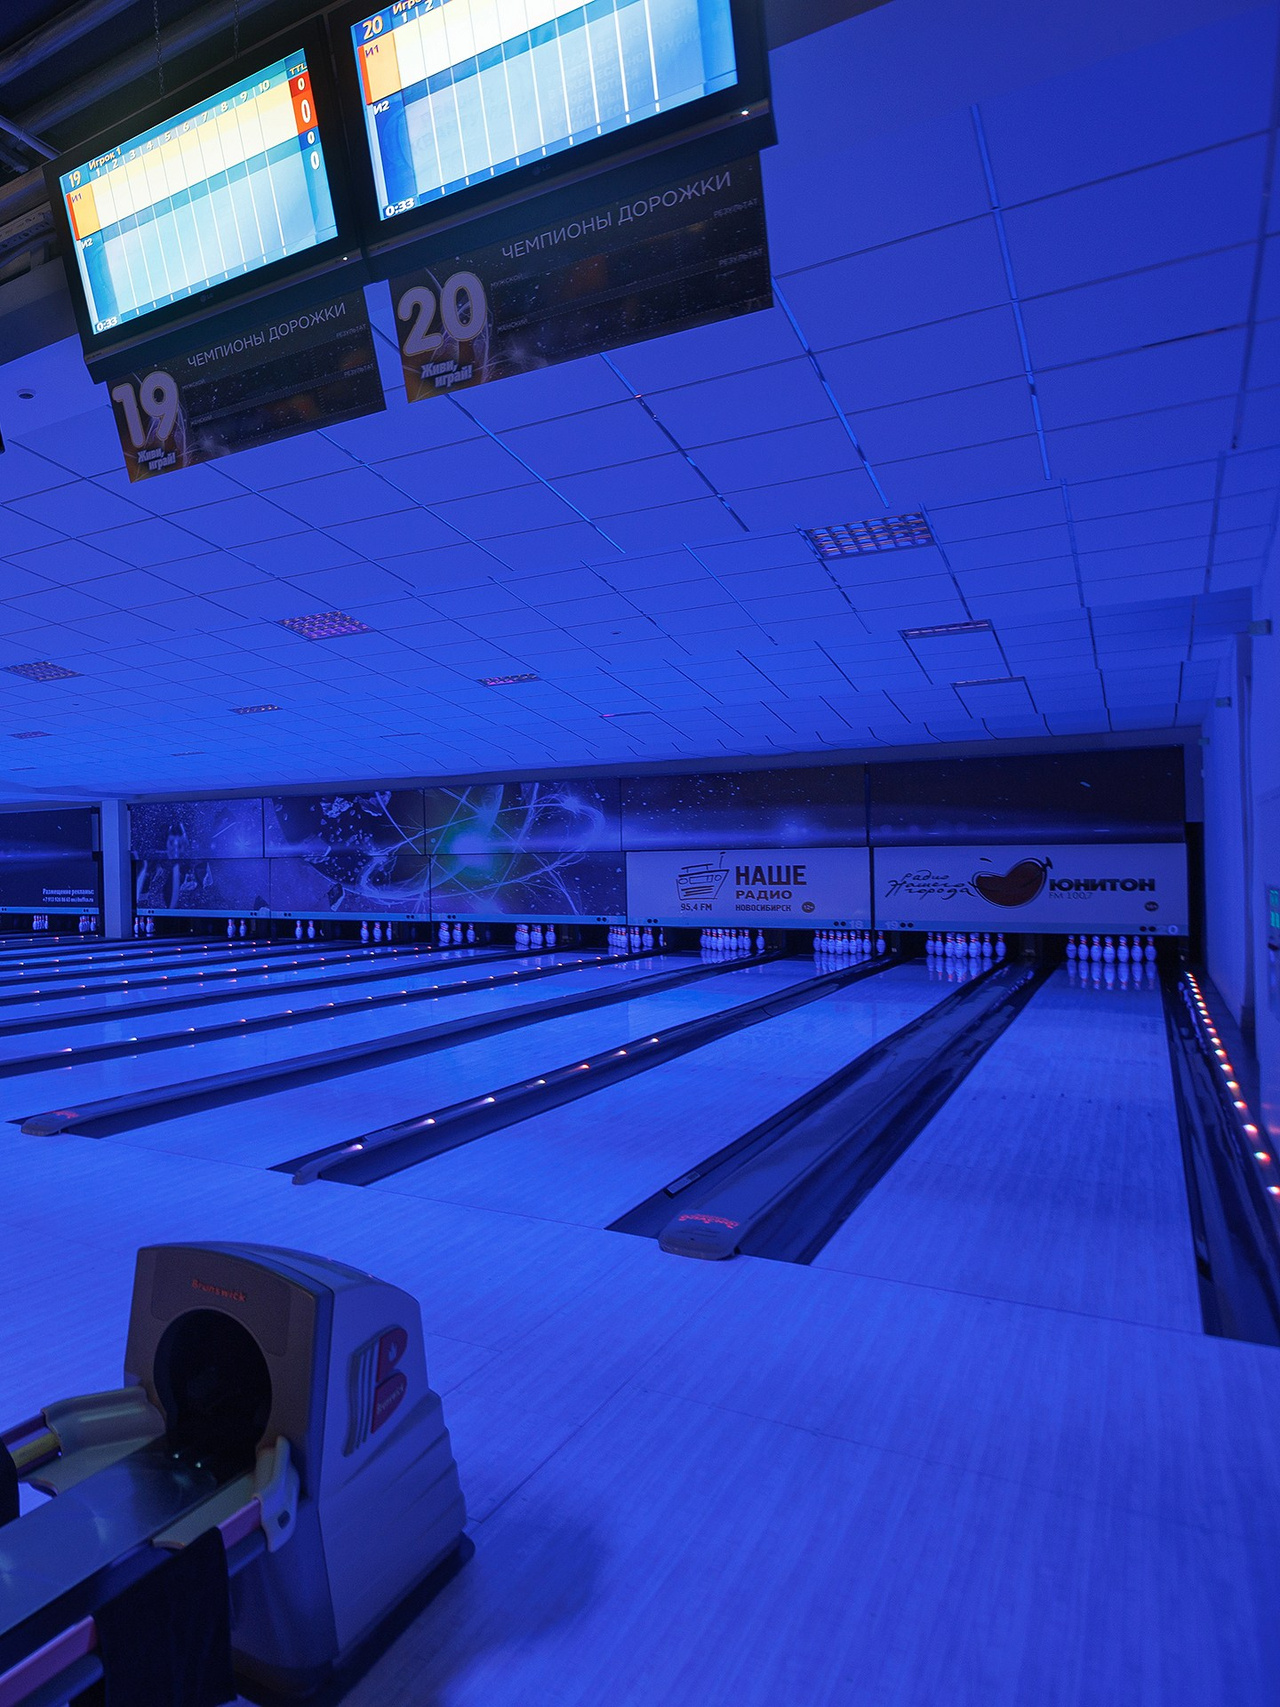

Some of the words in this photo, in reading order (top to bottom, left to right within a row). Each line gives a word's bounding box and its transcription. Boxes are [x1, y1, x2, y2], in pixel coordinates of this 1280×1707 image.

[402, 12, 408, 23] 1
[362, 15, 384, 40] 20
[365, 44, 380, 57] И1
[289, 63, 308, 76] TTL
[297, 78, 305, 91] 0
[301, 99, 311, 123] 0
[373, 100, 389, 115] И2
[95, 168, 101, 178] 1
[112, 158, 119, 169] 2
[129, 150, 136, 160] 3
[146, 141, 154, 151] 4
[164, 132, 171, 142] 5
[182, 122, 190, 132] 6
[202, 112, 209, 123] 7
[221, 102, 228, 112] 8
[240, 92, 248, 103] 9
[258, 80, 270, 93] 10
[307, 131, 315, 144] 0
[88, 152, 115, 171] Игрок
[310, 151, 320, 170] 0
[68, 170, 81, 188] 19
[71, 193, 83, 204] И1
[385, 197, 414, 217] 0:33
[502, 211, 612, 259] ЧЕМПИОНЫ
[618, 171, 732, 226] ДОРОЖКИ
[713, 198, 759, 218] РЕЗУЛЬТАТ
[80, 237, 93, 250] И2
[718, 247, 764, 267] РЕЗУЛЬТАТ
[397, 270, 487, 357] 20
[96, 317, 118, 332] 0:33
[187, 331, 265, 368] ЧЕМПИОНЫ
[269, 302, 346, 343] ДОРОЖКИ
[421, 360, 459, 380] Живи,
[434, 364, 473, 388] играй!
[111, 370, 179, 448] 19
[148, 452, 176, 471] играй!
[735, 864, 808, 886] НАШЕ
[901, 869, 949, 882] радио
[1048, 878, 1155, 892] ЮНИТОН
[735, 890, 793, 901] РАДИО
[905, 887, 977, 900] города
[1049, 891, 1064, 899] FM
[680, 903, 699, 912] 95,4
[700, 903, 712, 911] FM
[735, 904, 792, 912] НОВОСИБИРСК
[849, 920, 864, 929] 18
[1157, 924, 1179, 935] 20
[191, 1279, 246, 1302] Brunswick
